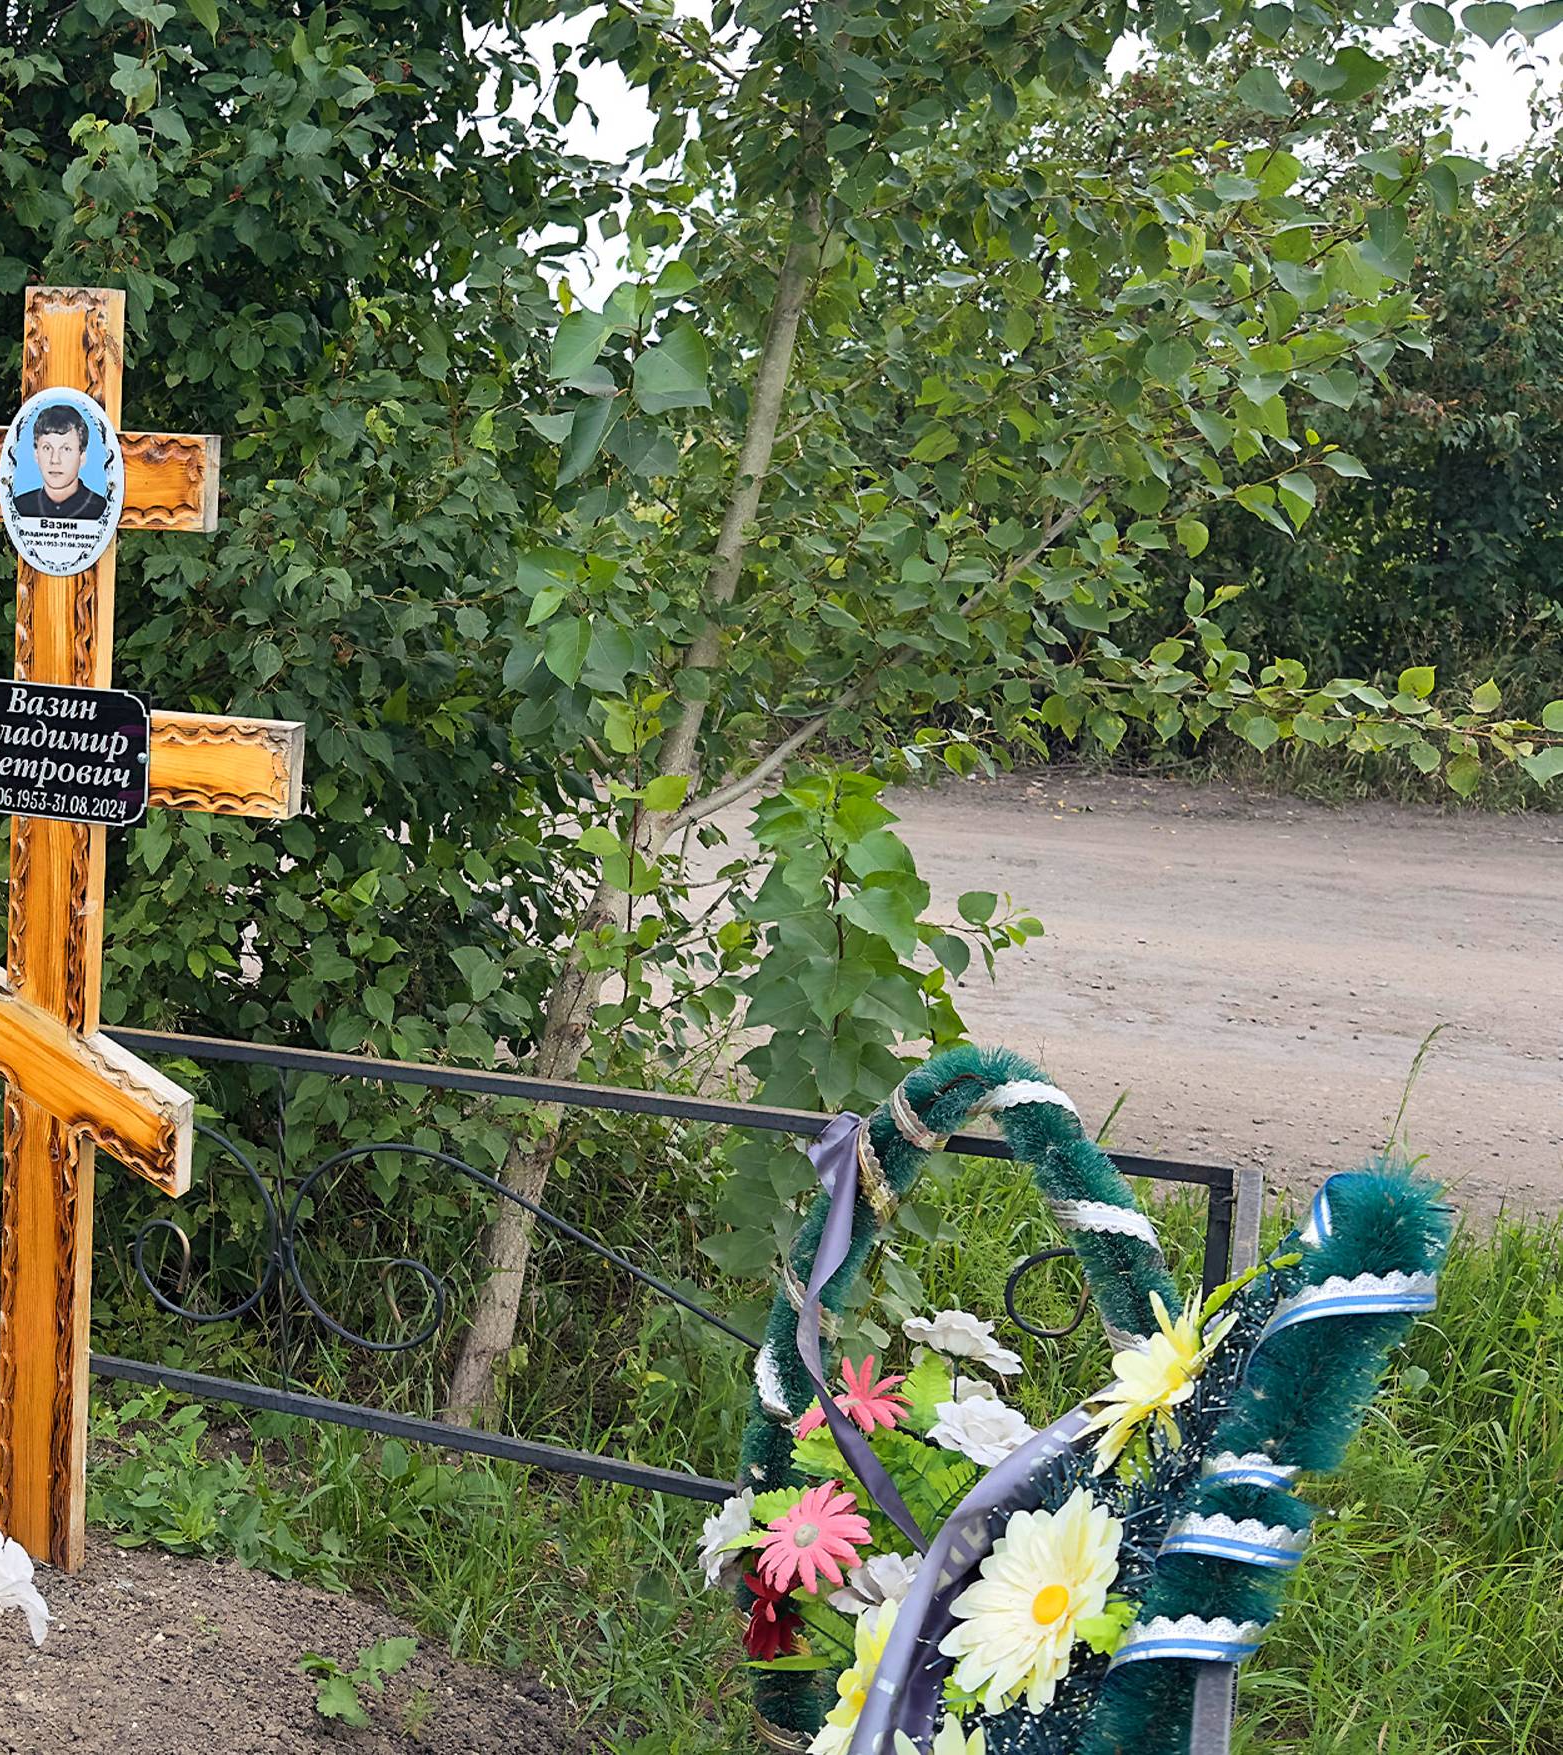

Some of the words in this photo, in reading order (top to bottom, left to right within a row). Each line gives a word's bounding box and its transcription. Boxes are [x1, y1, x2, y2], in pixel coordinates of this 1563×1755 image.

[40, 519, 77, 530] Вазин
[19, 529, 59, 539] Владимир
[61, 532, 100, 540] Петрович
[7, 687, 97, 720] Вазин
